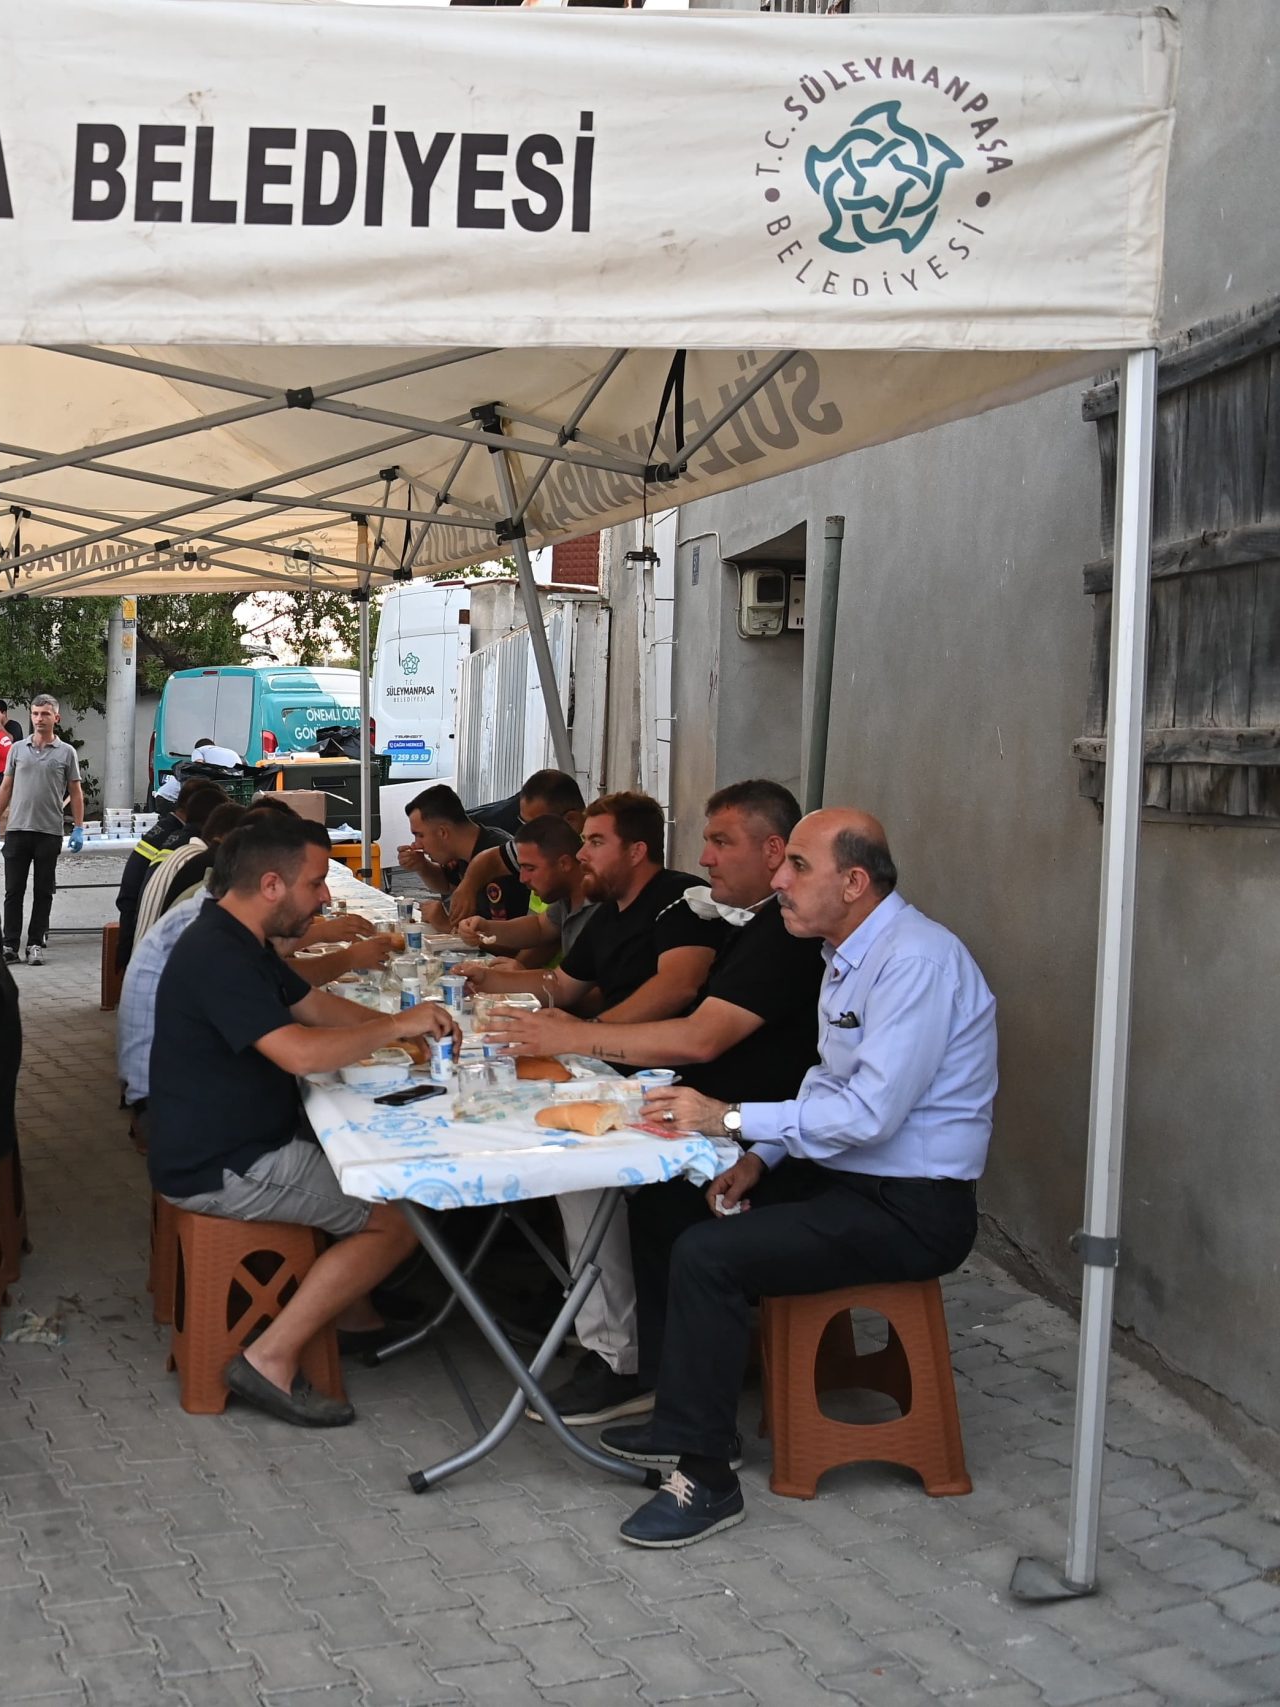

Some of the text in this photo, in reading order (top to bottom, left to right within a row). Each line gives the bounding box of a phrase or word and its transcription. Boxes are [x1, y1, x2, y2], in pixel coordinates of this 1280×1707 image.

[756, 57, 1013, 176] T.C. SÜLEYMANPAŞA
[72, 105, 595, 233] BELEDİYESİ
[767, 215, 984, 296] BELEDİYESİ
[386, 685, 435, 696] SÜLEYMANPAŞA
